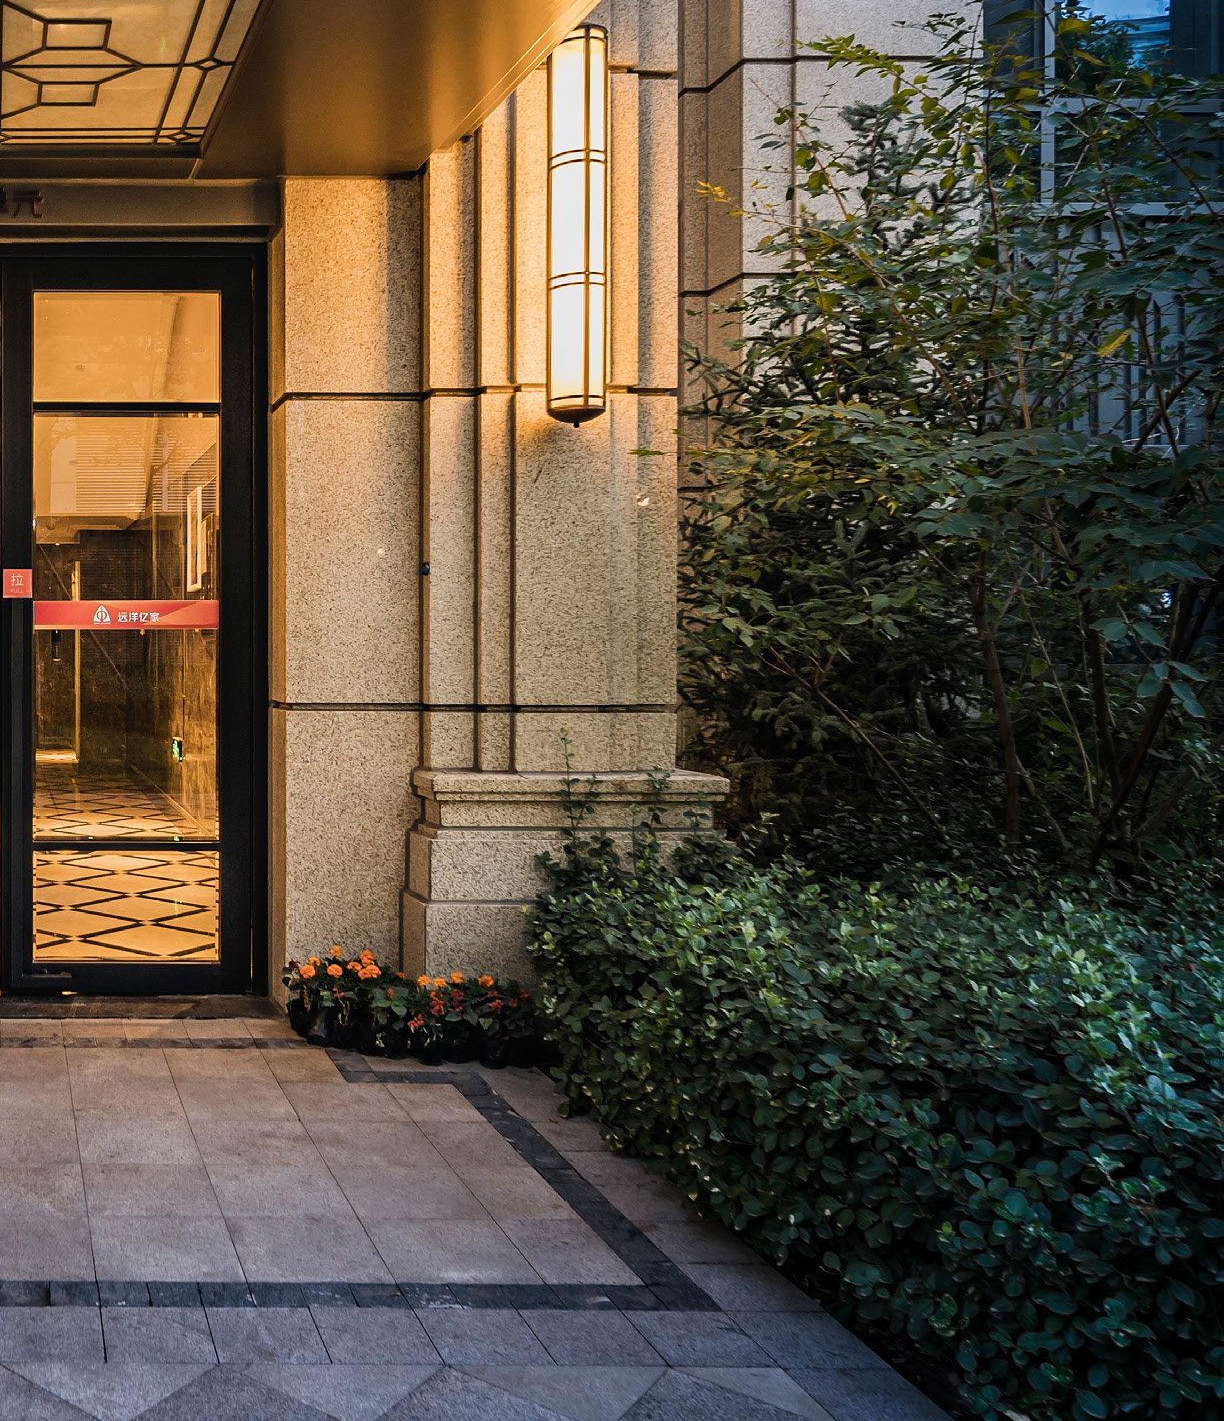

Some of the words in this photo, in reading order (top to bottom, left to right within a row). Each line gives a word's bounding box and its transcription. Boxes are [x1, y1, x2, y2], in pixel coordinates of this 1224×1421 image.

[11, 573, 24, 586] 拉
[117, 612, 160, 623] 远洋亿家
